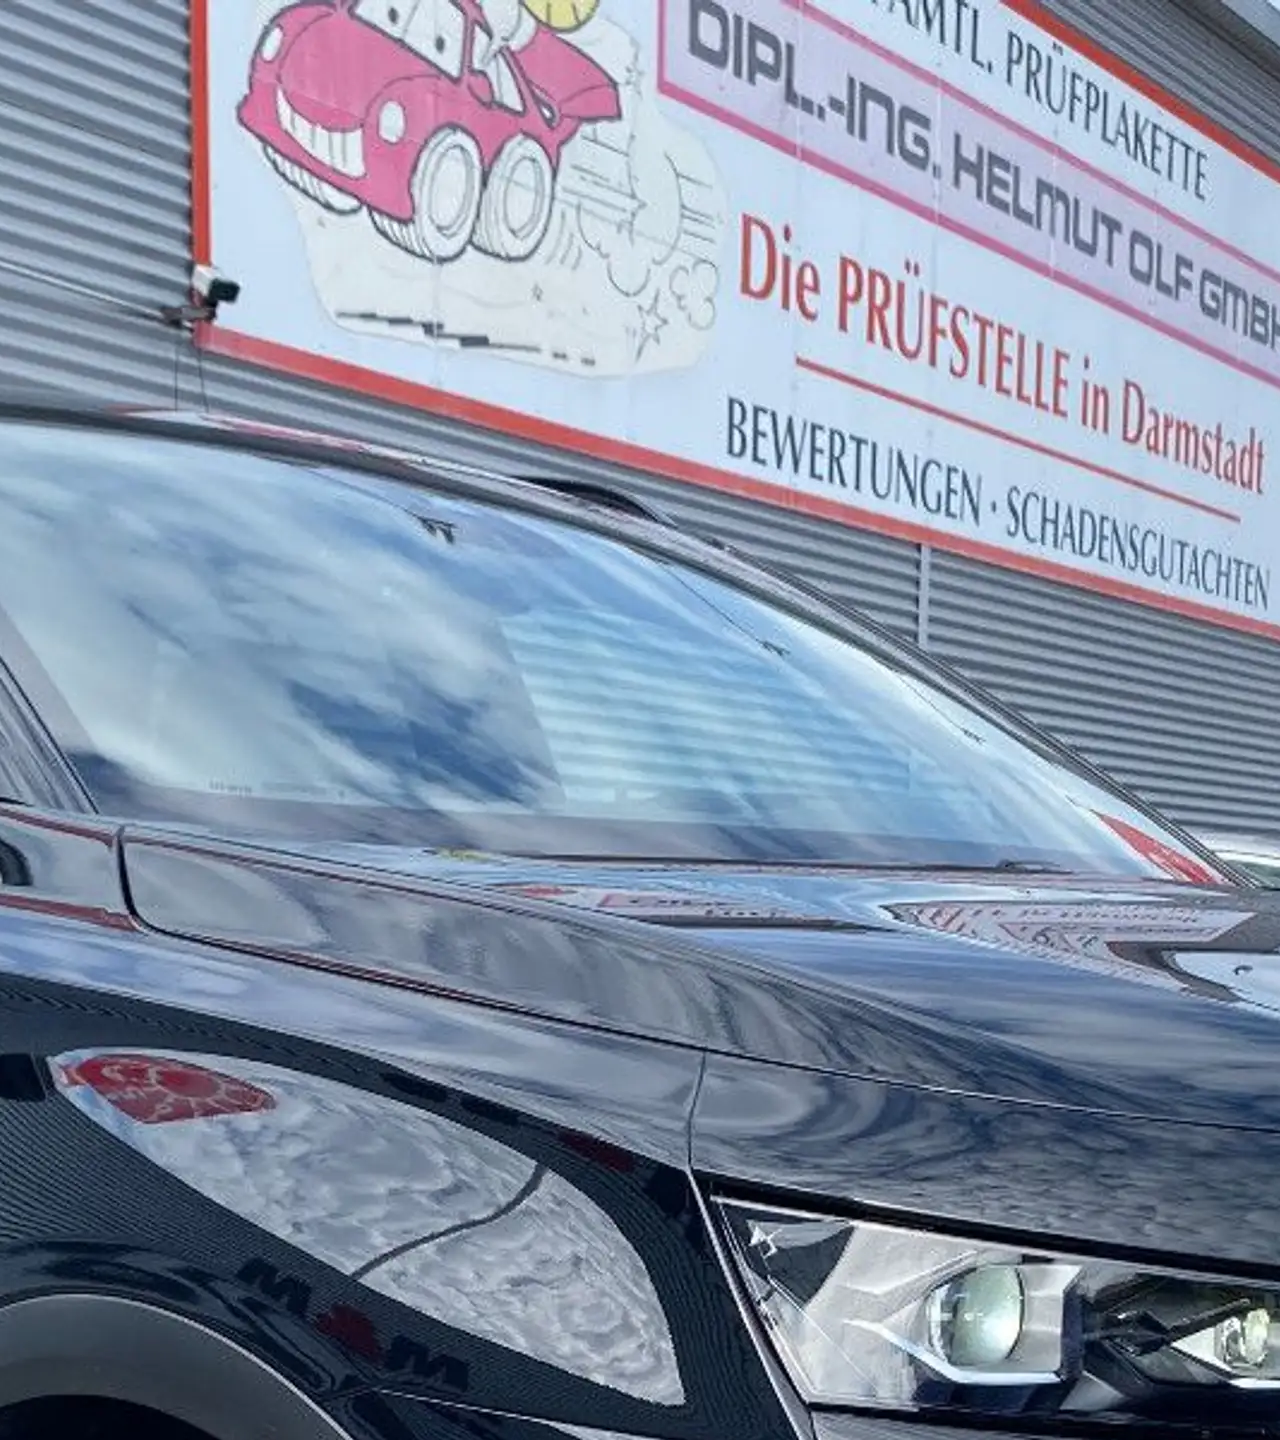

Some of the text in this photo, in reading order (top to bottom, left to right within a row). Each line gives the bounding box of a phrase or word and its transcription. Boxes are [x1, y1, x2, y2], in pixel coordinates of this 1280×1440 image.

[689, 0, 941, 179] DIPL.-ING.
[954, 132, 1123, 268] HELMUT
[1129, 230, 1193, 301] OLF
[1007, 31, 1208, 201] PRÜFPLAKETTE
[740, 212, 1265, 495] Die PRÜFSTELLE in Darmstadt
[726, 396, 1270, 611] BEWERTUNGEN SCHADENSGUTACHTEN
